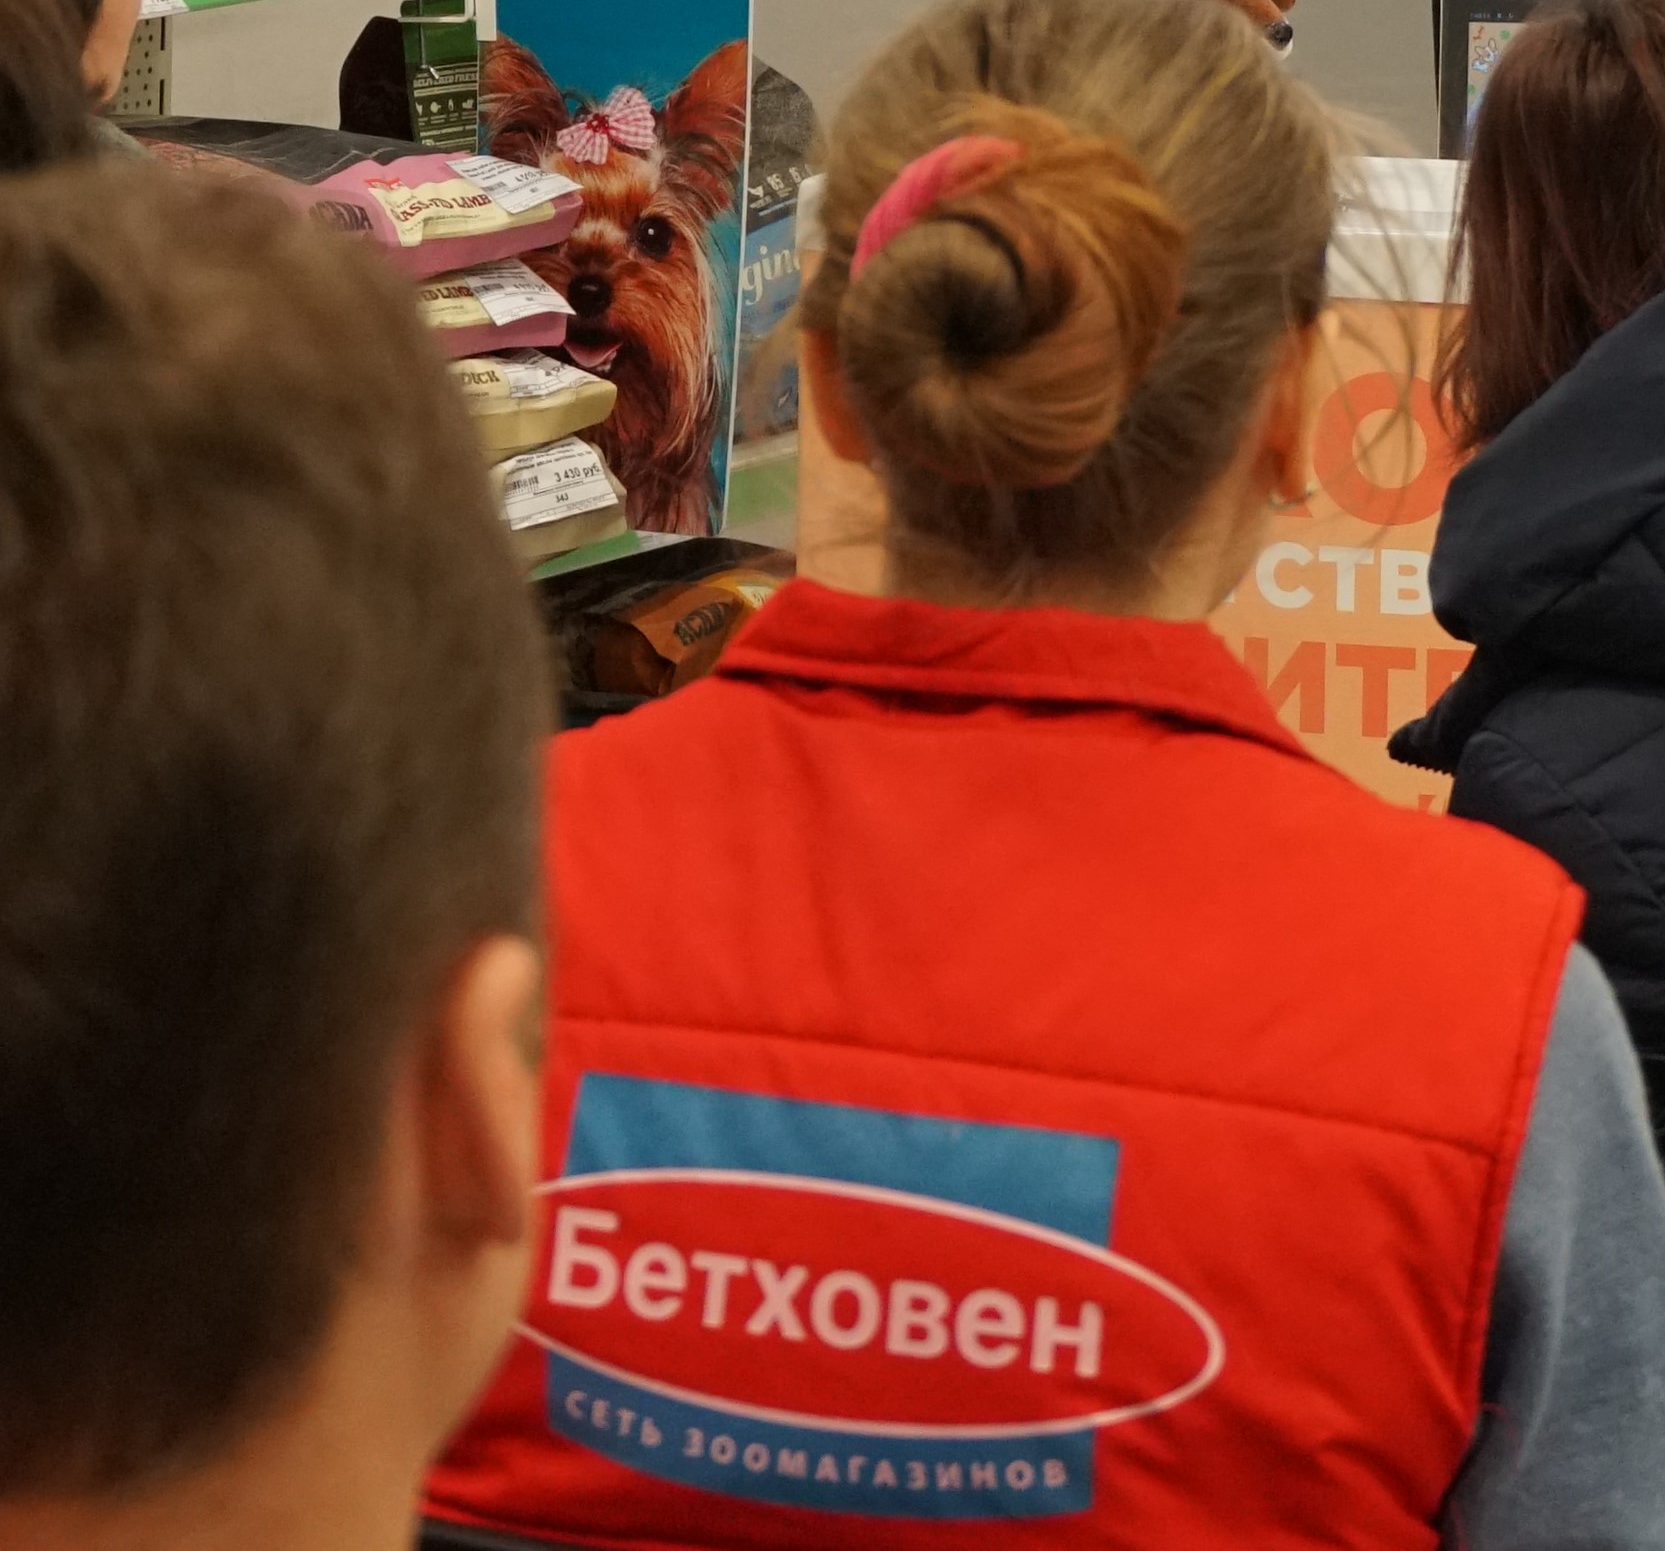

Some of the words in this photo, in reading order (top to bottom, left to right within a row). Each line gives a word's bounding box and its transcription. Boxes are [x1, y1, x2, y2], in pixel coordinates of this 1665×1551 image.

[547, 1204, 1105, 1378] Бетховен
[564, 1388, 665, 1449] СЕТЬ
[683, 1425, 1070, 1491] ЗООМАГАЗИНОВ
